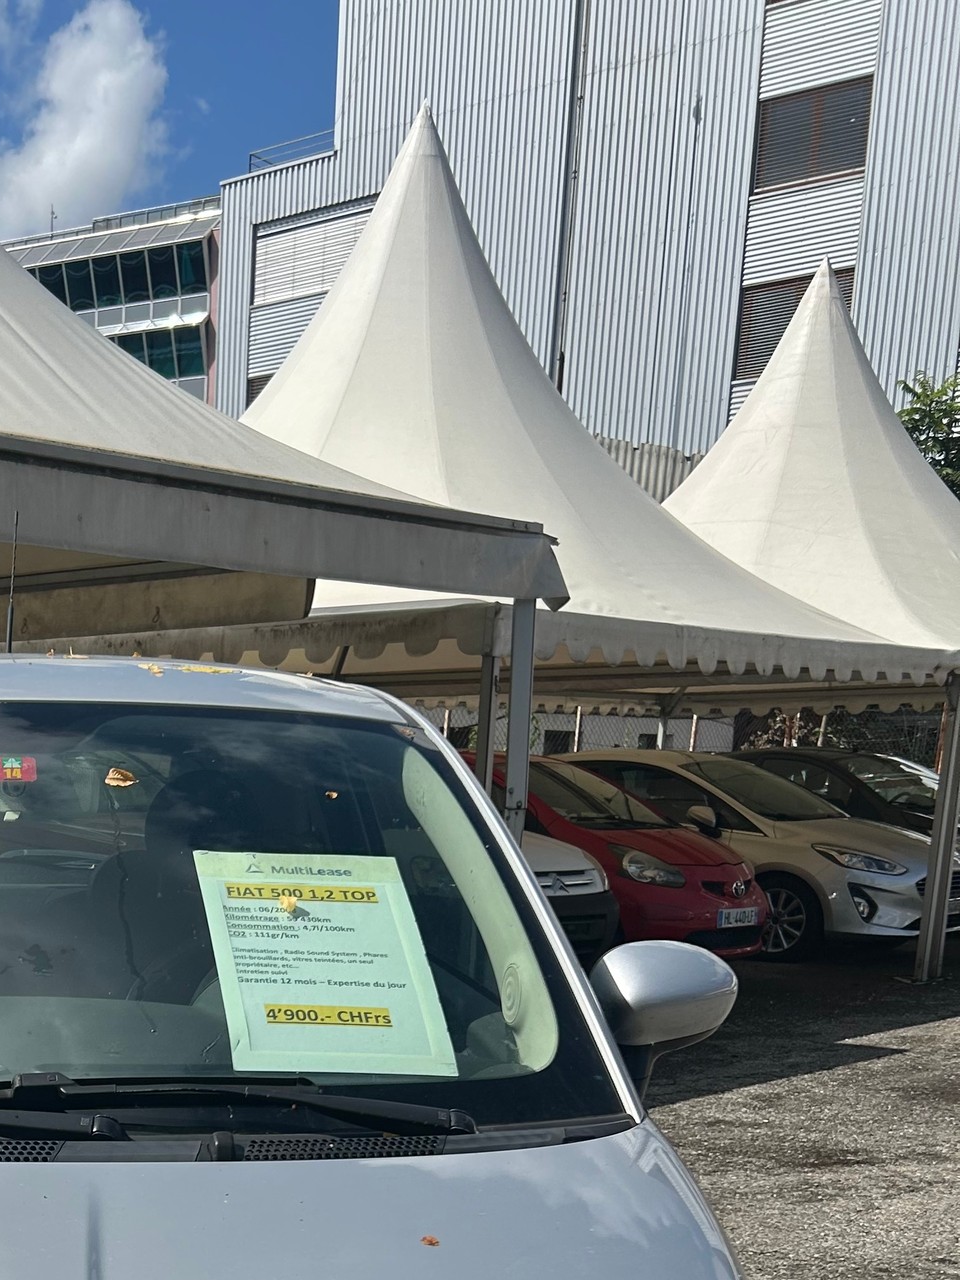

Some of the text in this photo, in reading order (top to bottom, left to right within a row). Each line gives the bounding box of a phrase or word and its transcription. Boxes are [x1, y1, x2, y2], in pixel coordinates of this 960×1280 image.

[3, 768, 22, 779] 14
[271, 866, 352, 876] MultiLease
[226, 886, 376, 901] FIAT 500 1,2 TOP
[254, 931, 299, 940] 111gr/km
[237, 976, 278, 984] Garantie
[327, 979, 371, 987] Expertise
[387, 981, 407, 989] jour
[336, 1010, 392, 1024] CHFrs
